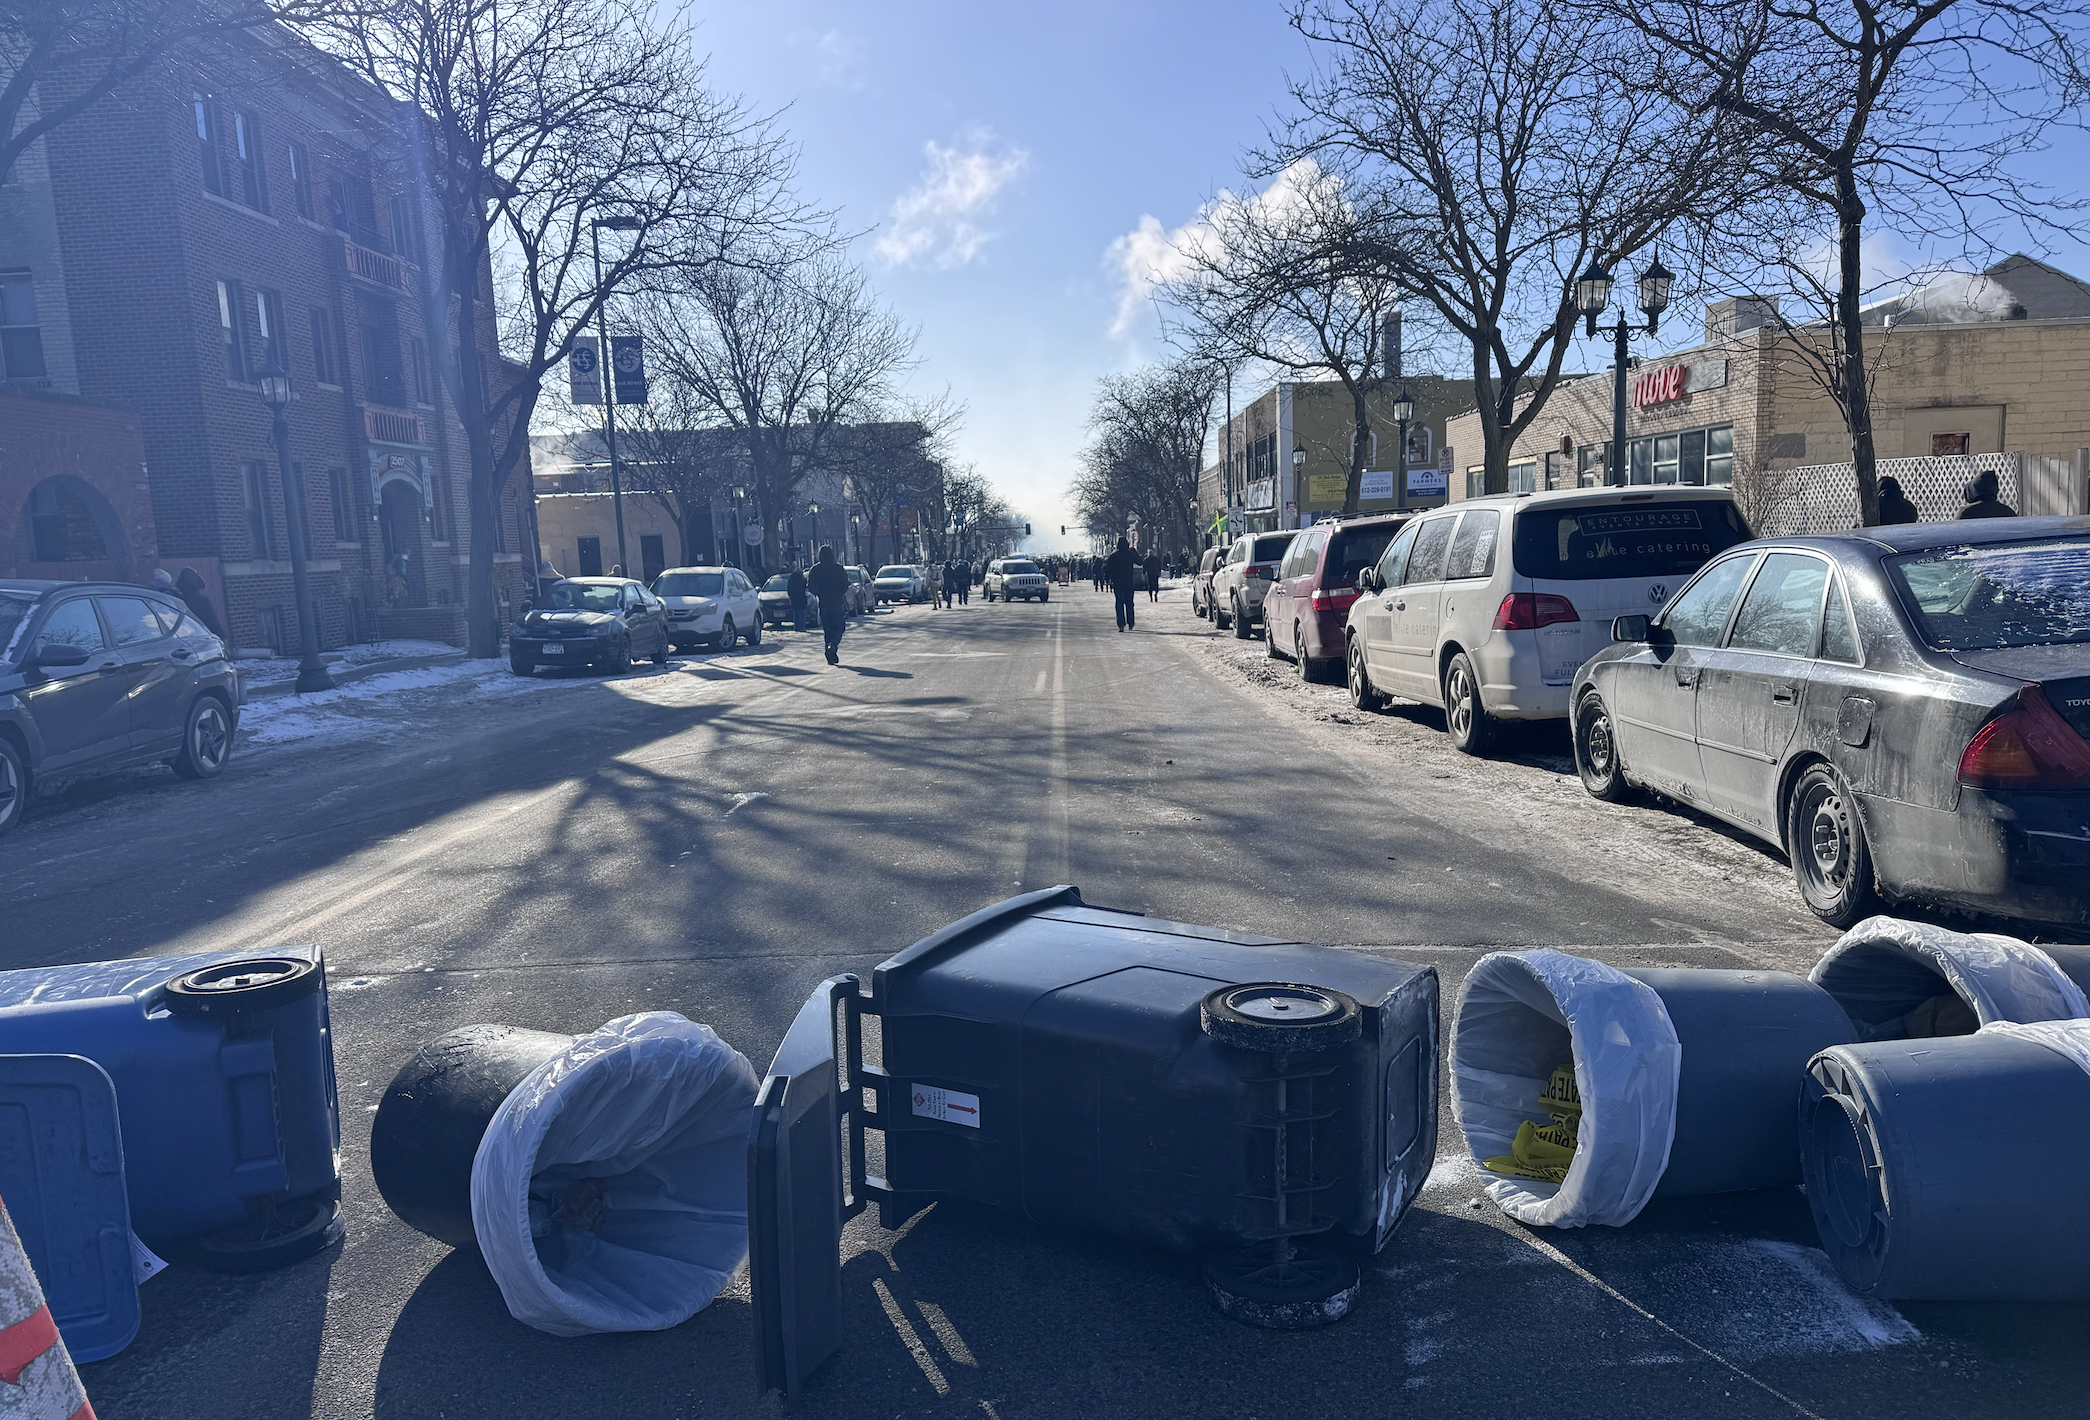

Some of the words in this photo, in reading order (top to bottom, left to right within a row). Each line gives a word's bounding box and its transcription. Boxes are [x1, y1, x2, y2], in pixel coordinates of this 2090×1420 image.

[390, 455, 405, 467] 2507
[1587, 513, 1692, 526] ENTOURAGE
[1591, 522, 1640, 530] EVENTS
[1636, 541, 1711, 554] catering
